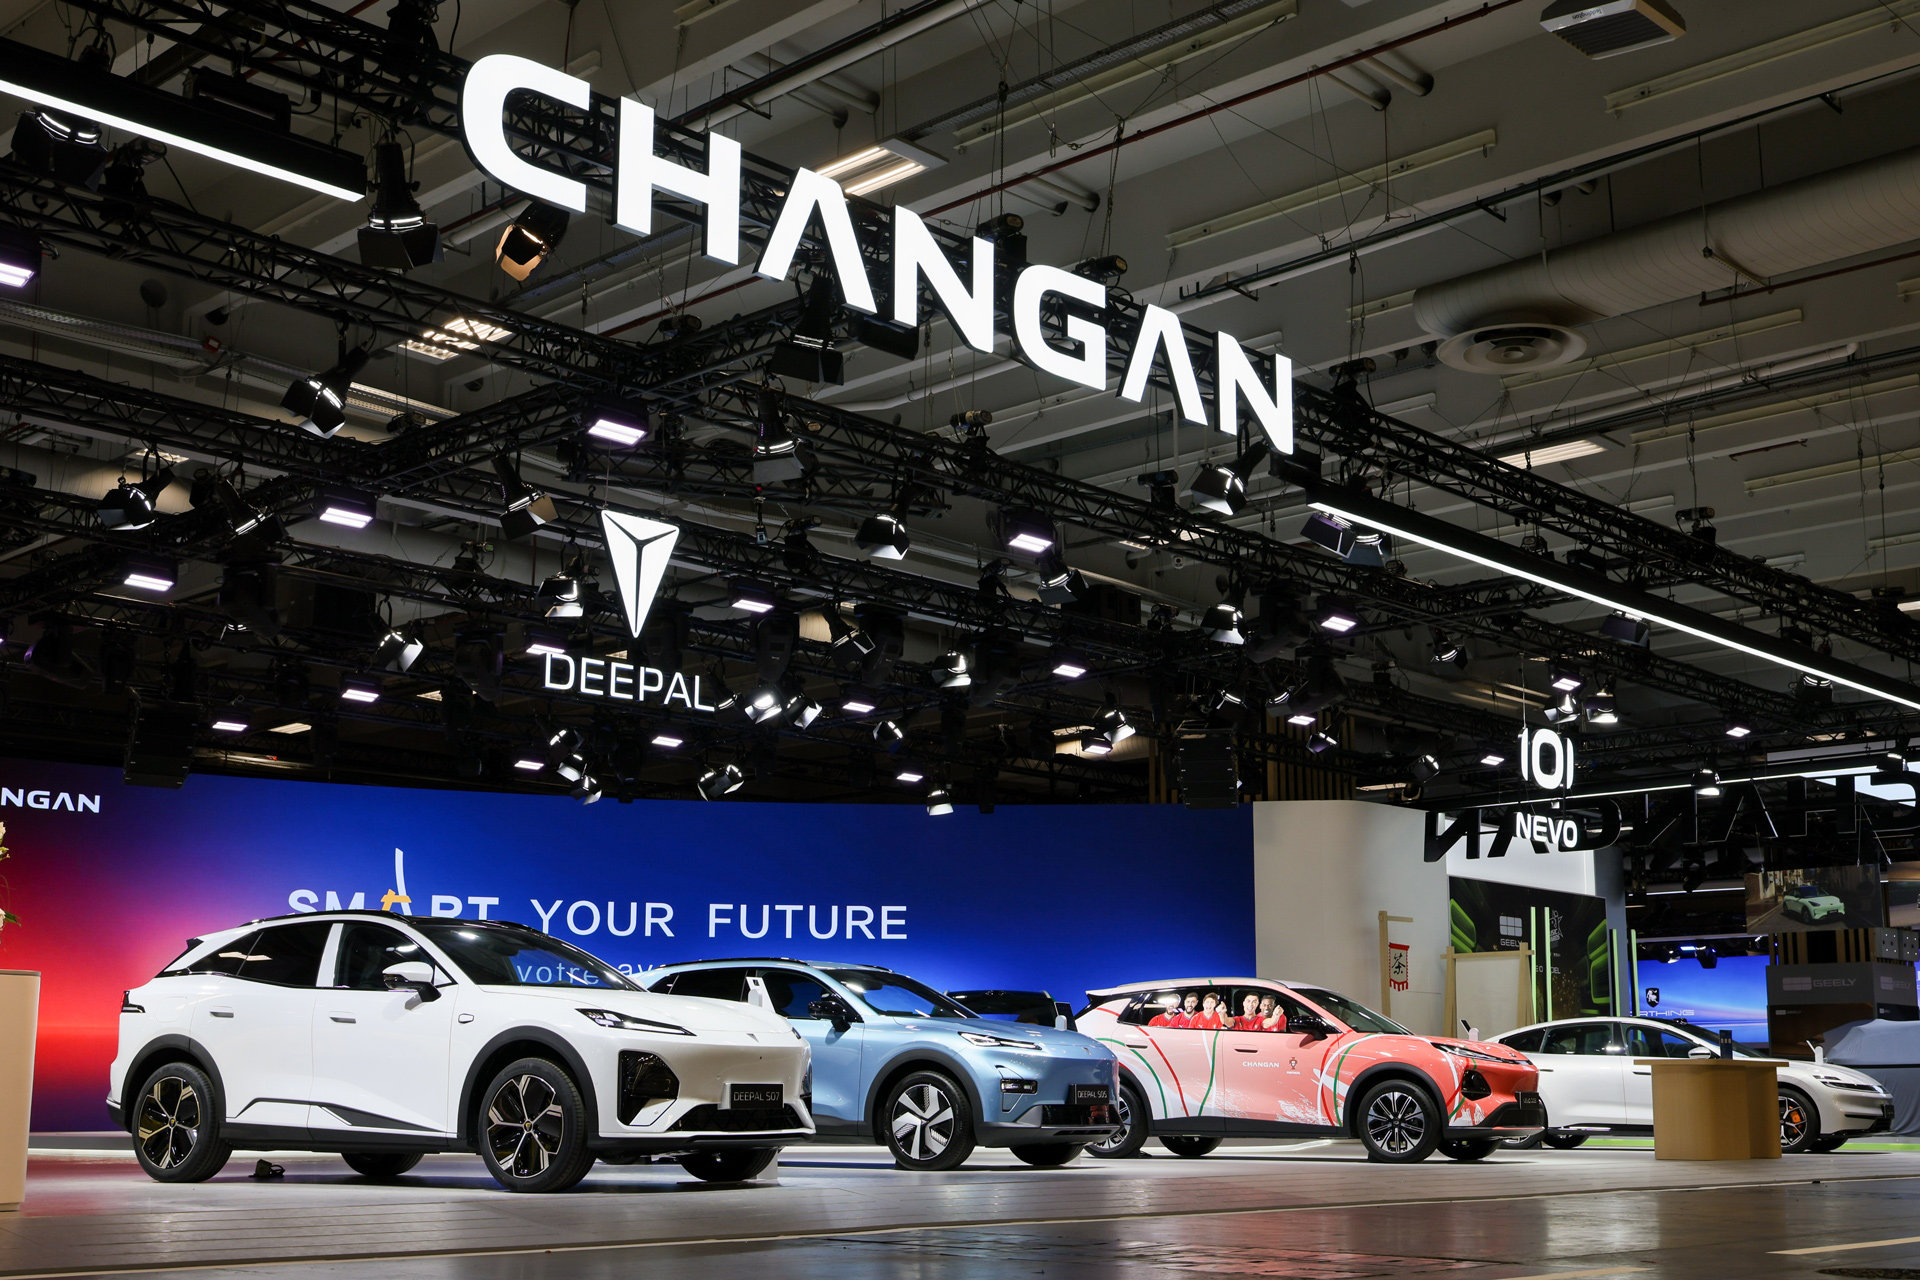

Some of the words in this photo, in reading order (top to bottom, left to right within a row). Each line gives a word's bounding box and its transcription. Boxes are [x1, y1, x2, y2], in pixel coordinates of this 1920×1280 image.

[462, 54, 1293, 455] CHANGAN
[544, 652, 715, 712] DEEPAL
[0, 787, 101, 814] NGAN
[1516, 811, 1578, 848] NEVO
[530, 899, 676, 937] YOUR
[708, 903, 908, 940] FUTURE
[1500, 938, 1522, 948] GEEL
[516, 962, 600, 985] votre
[1813, 978, 1857, 988] GEELY
[733, 1091, 764, 1101] DEEPAL
[765, 1091, 780, 1101] S07
[1077, 1090, 1096, 1099] DEEPAL
